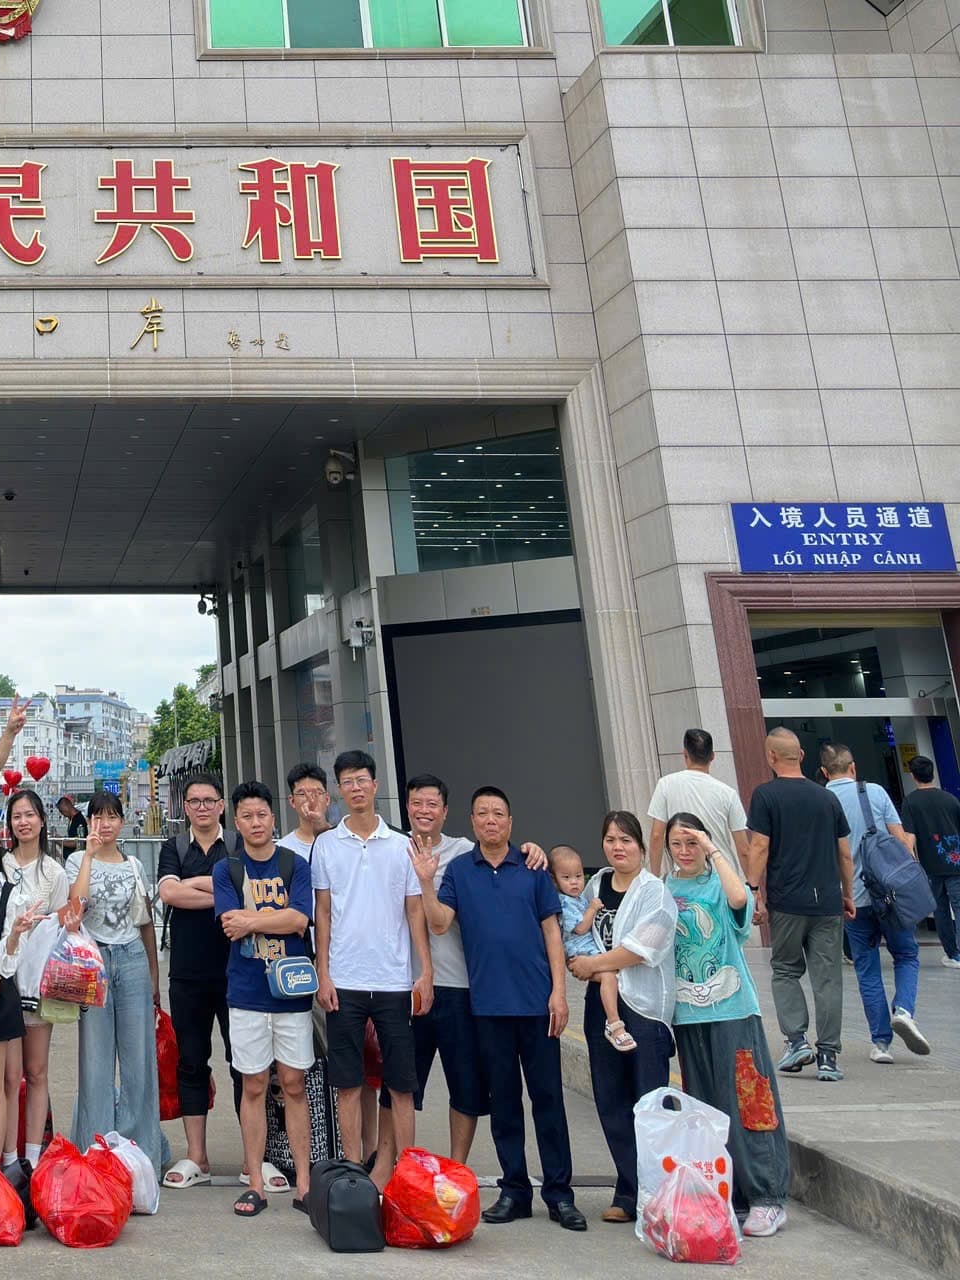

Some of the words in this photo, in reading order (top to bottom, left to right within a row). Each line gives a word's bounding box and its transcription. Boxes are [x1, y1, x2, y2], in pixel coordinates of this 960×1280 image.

[749, 506, 933, 529] 入境人员通道
[801, 532, 885, 546] ENTRY
[773, 551, 803, 566] LỐI
[814, 550, 862, 567] NHẬP
[873, 550, 923, 565] CẢNH
